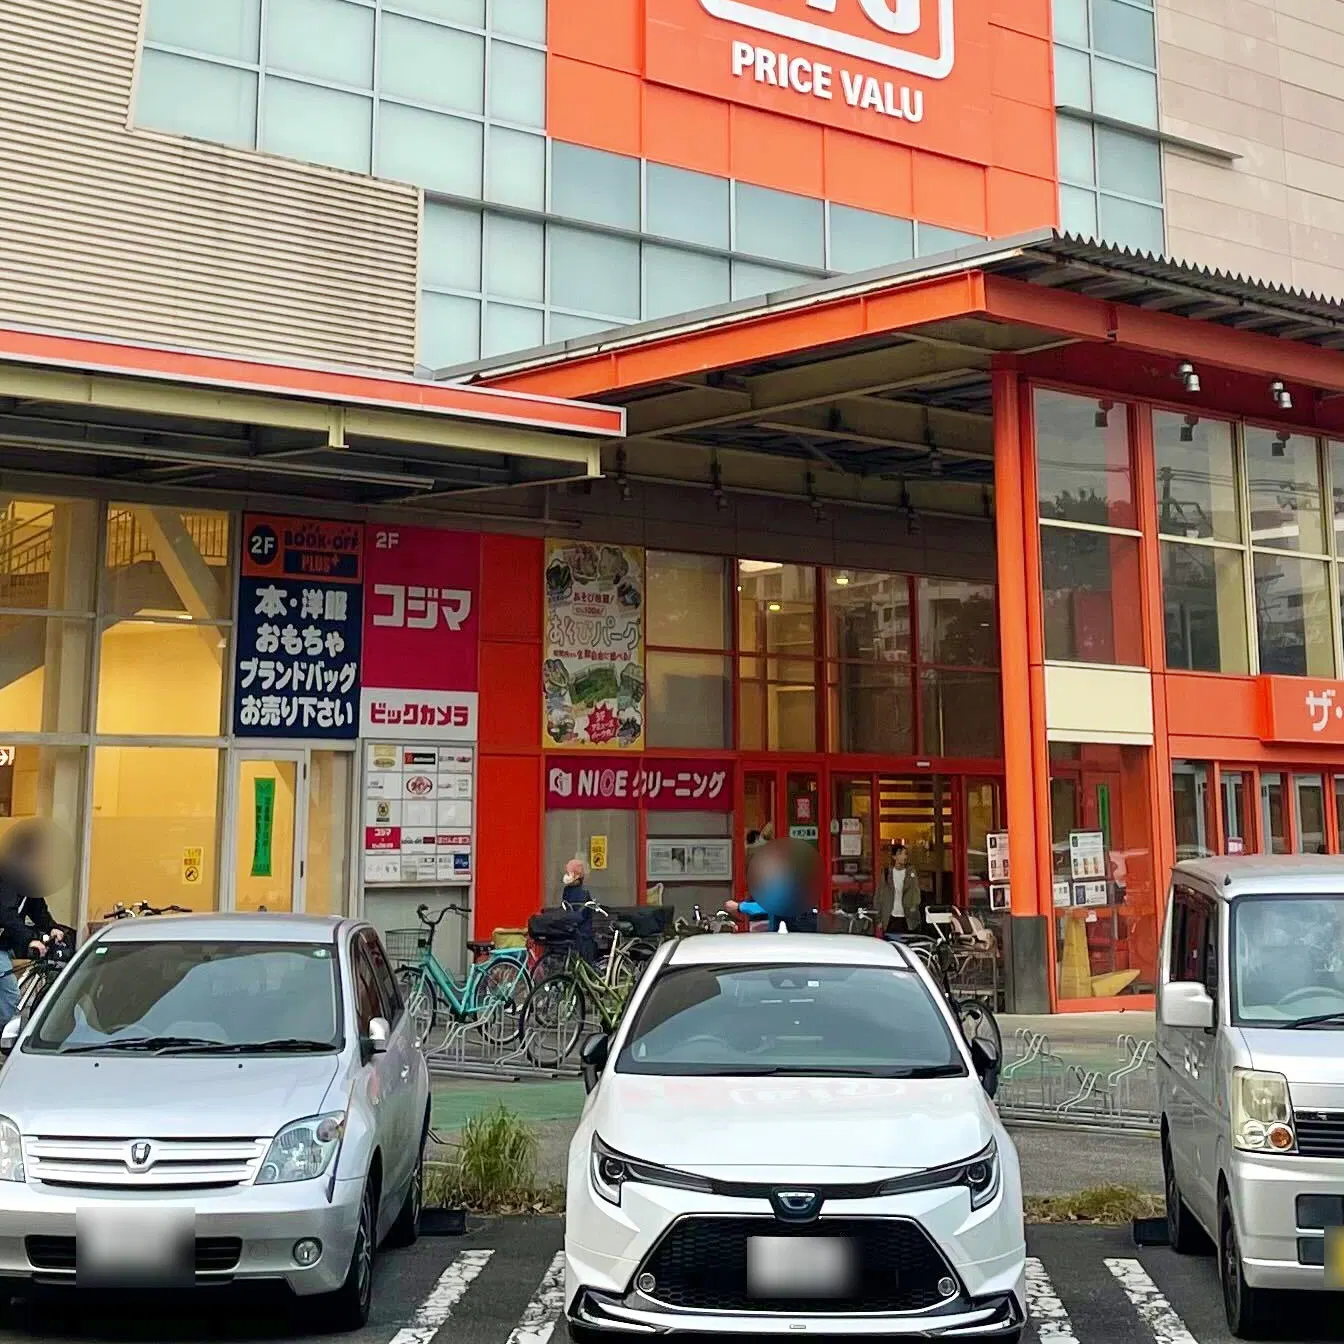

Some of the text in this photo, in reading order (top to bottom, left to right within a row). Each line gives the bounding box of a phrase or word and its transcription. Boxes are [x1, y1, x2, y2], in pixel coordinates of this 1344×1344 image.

[732, 40, 924, 123] PRICE VALU
[251, 535, 276, 555] 2F
[375, 532, 400, 549] 2F
[373, 584, 472, 631] コジマ
[256, 623, 345, 658] おもちゃ
[239, 657, 357, 694] ブランドバッグ
[240, 694, 353, 728] お売り下さい
[370, 702, 469, 727] ビックカメラ
[577, 769, 727, 800] NICE クリーニング
